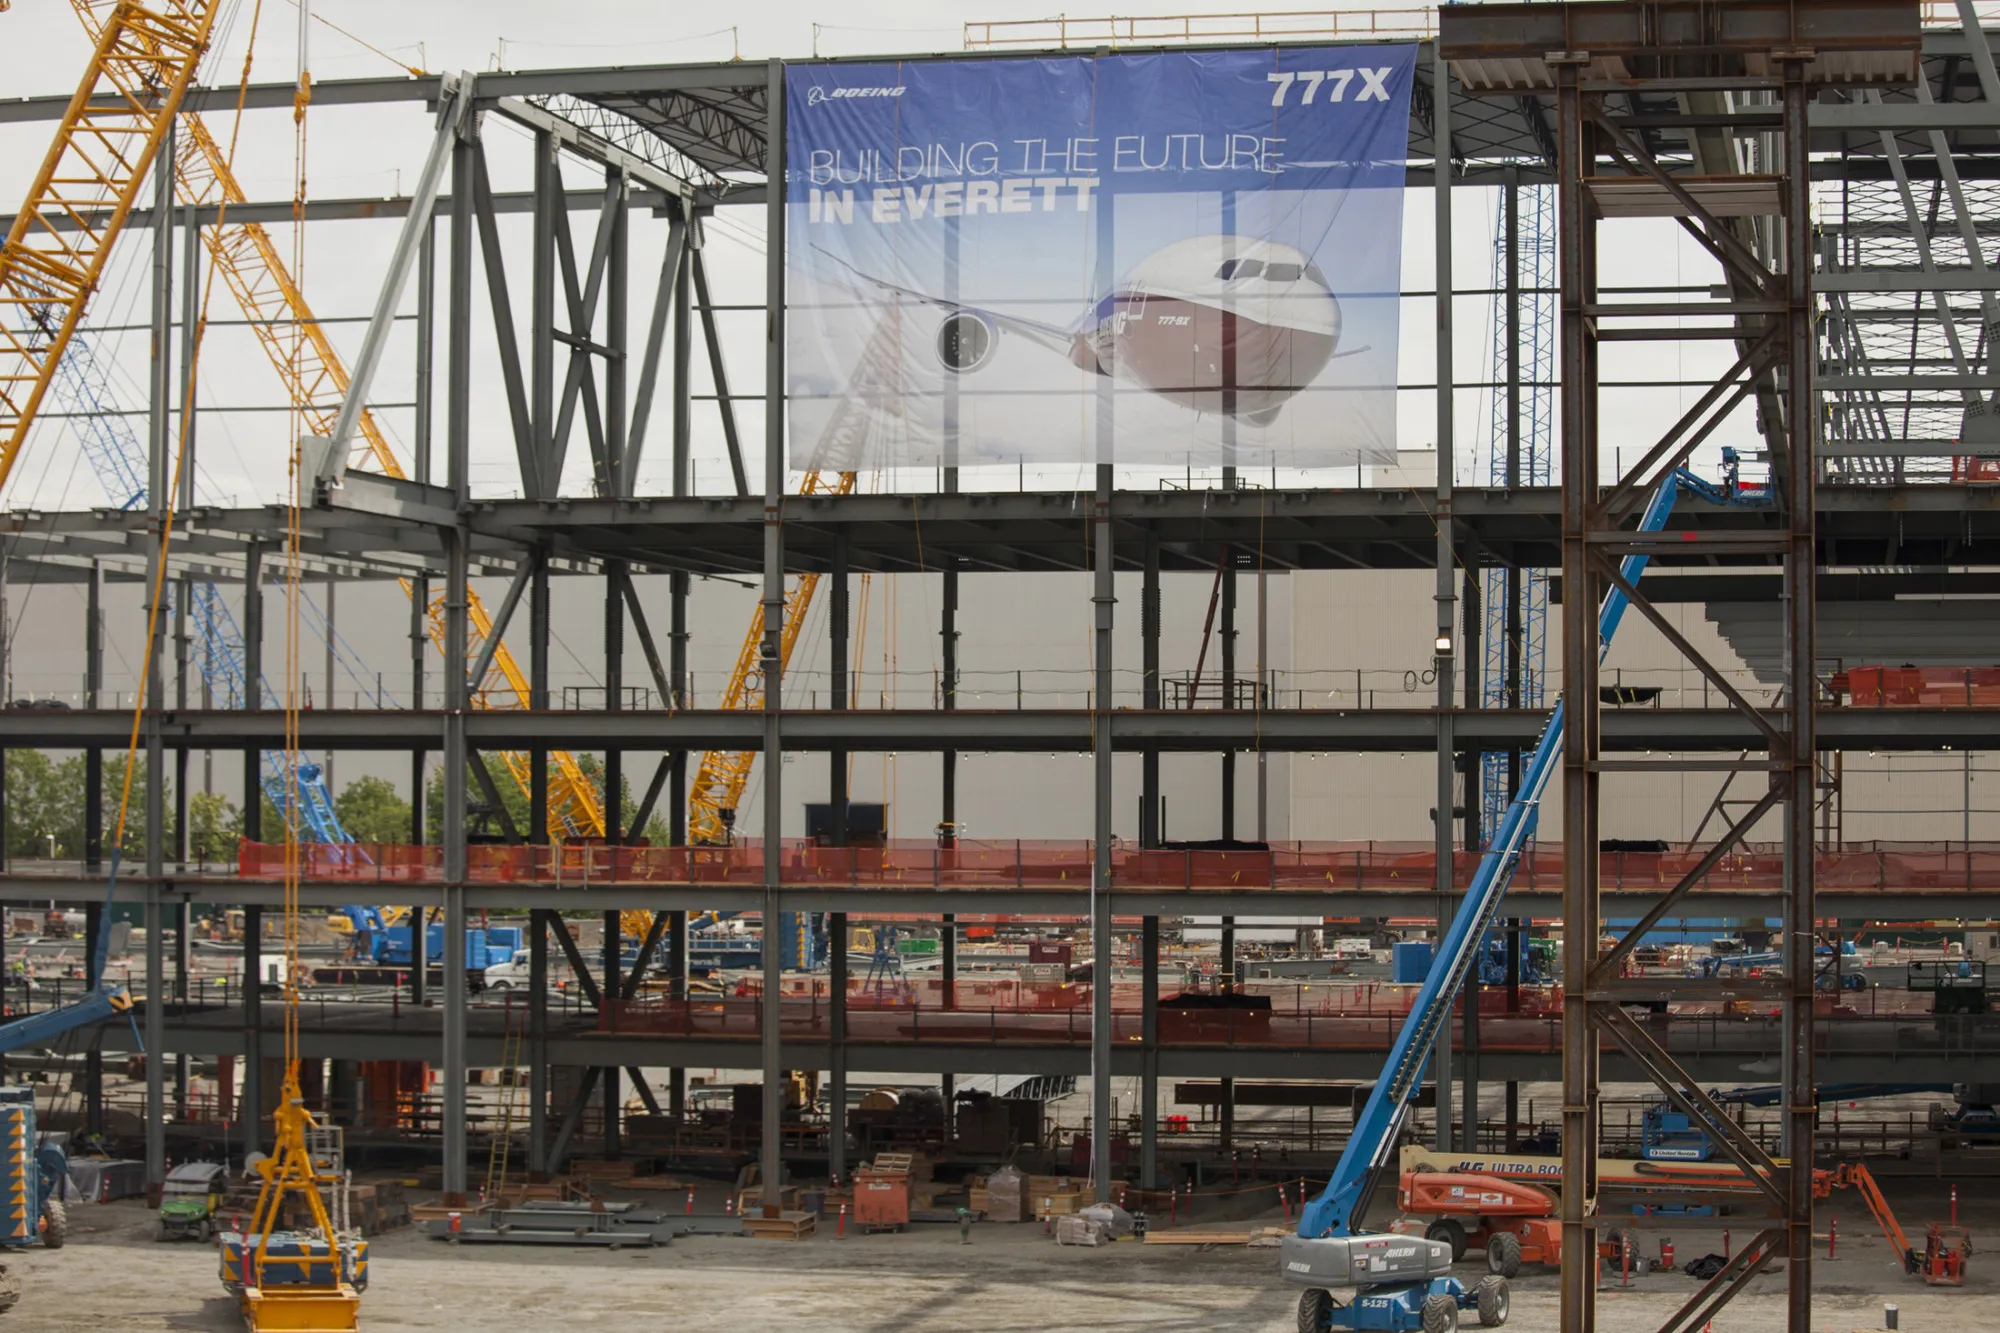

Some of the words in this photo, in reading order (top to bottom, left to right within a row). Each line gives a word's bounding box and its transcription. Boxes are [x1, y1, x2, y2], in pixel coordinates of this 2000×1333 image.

[831, 87, 907, 98] BOEING
[1268, 67, 1393, 107] 777X
[810, 141, 999, 185] BUILDING
[1013, 138, 1099, 173] THE
[1113, 134, 1287, 174] FUTURE
[809, 188, 854, 225] IN
[872, 177, 1100, 223] EVERETT
[1491, 1163, 1534, 1174] ULTRA
[1361, 1298, 1388, 1308] S-125
